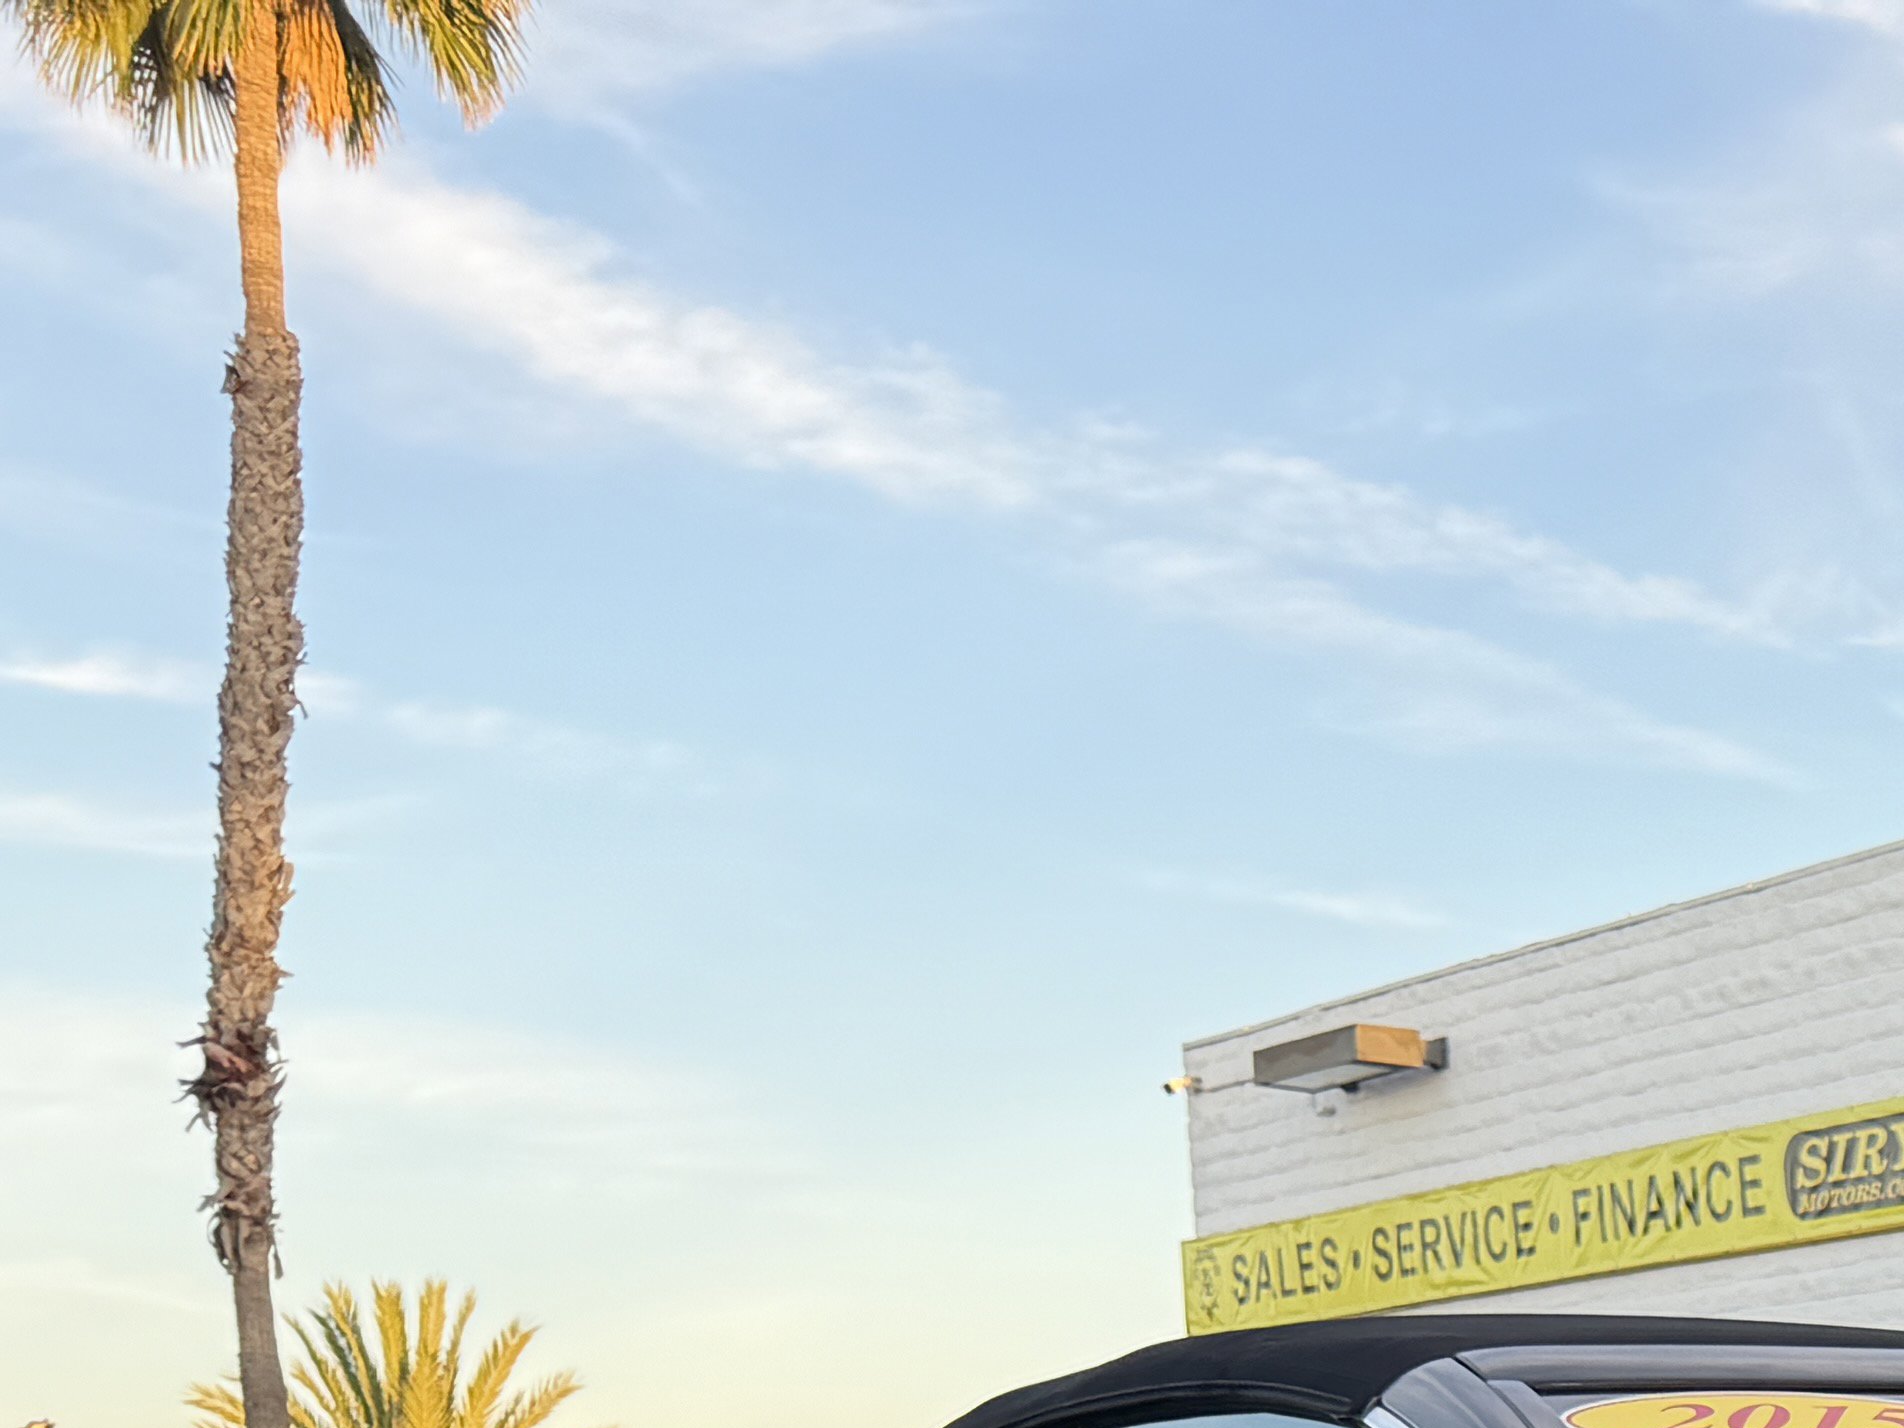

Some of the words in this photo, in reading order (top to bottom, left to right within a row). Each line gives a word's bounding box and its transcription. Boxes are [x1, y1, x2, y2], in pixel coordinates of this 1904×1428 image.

[1231, 1236, 1343, 1306] SALES
[1371, 1199, 1537, 1283] SERVICE
[1572, 1154, 1768, 1248] FINANCE
